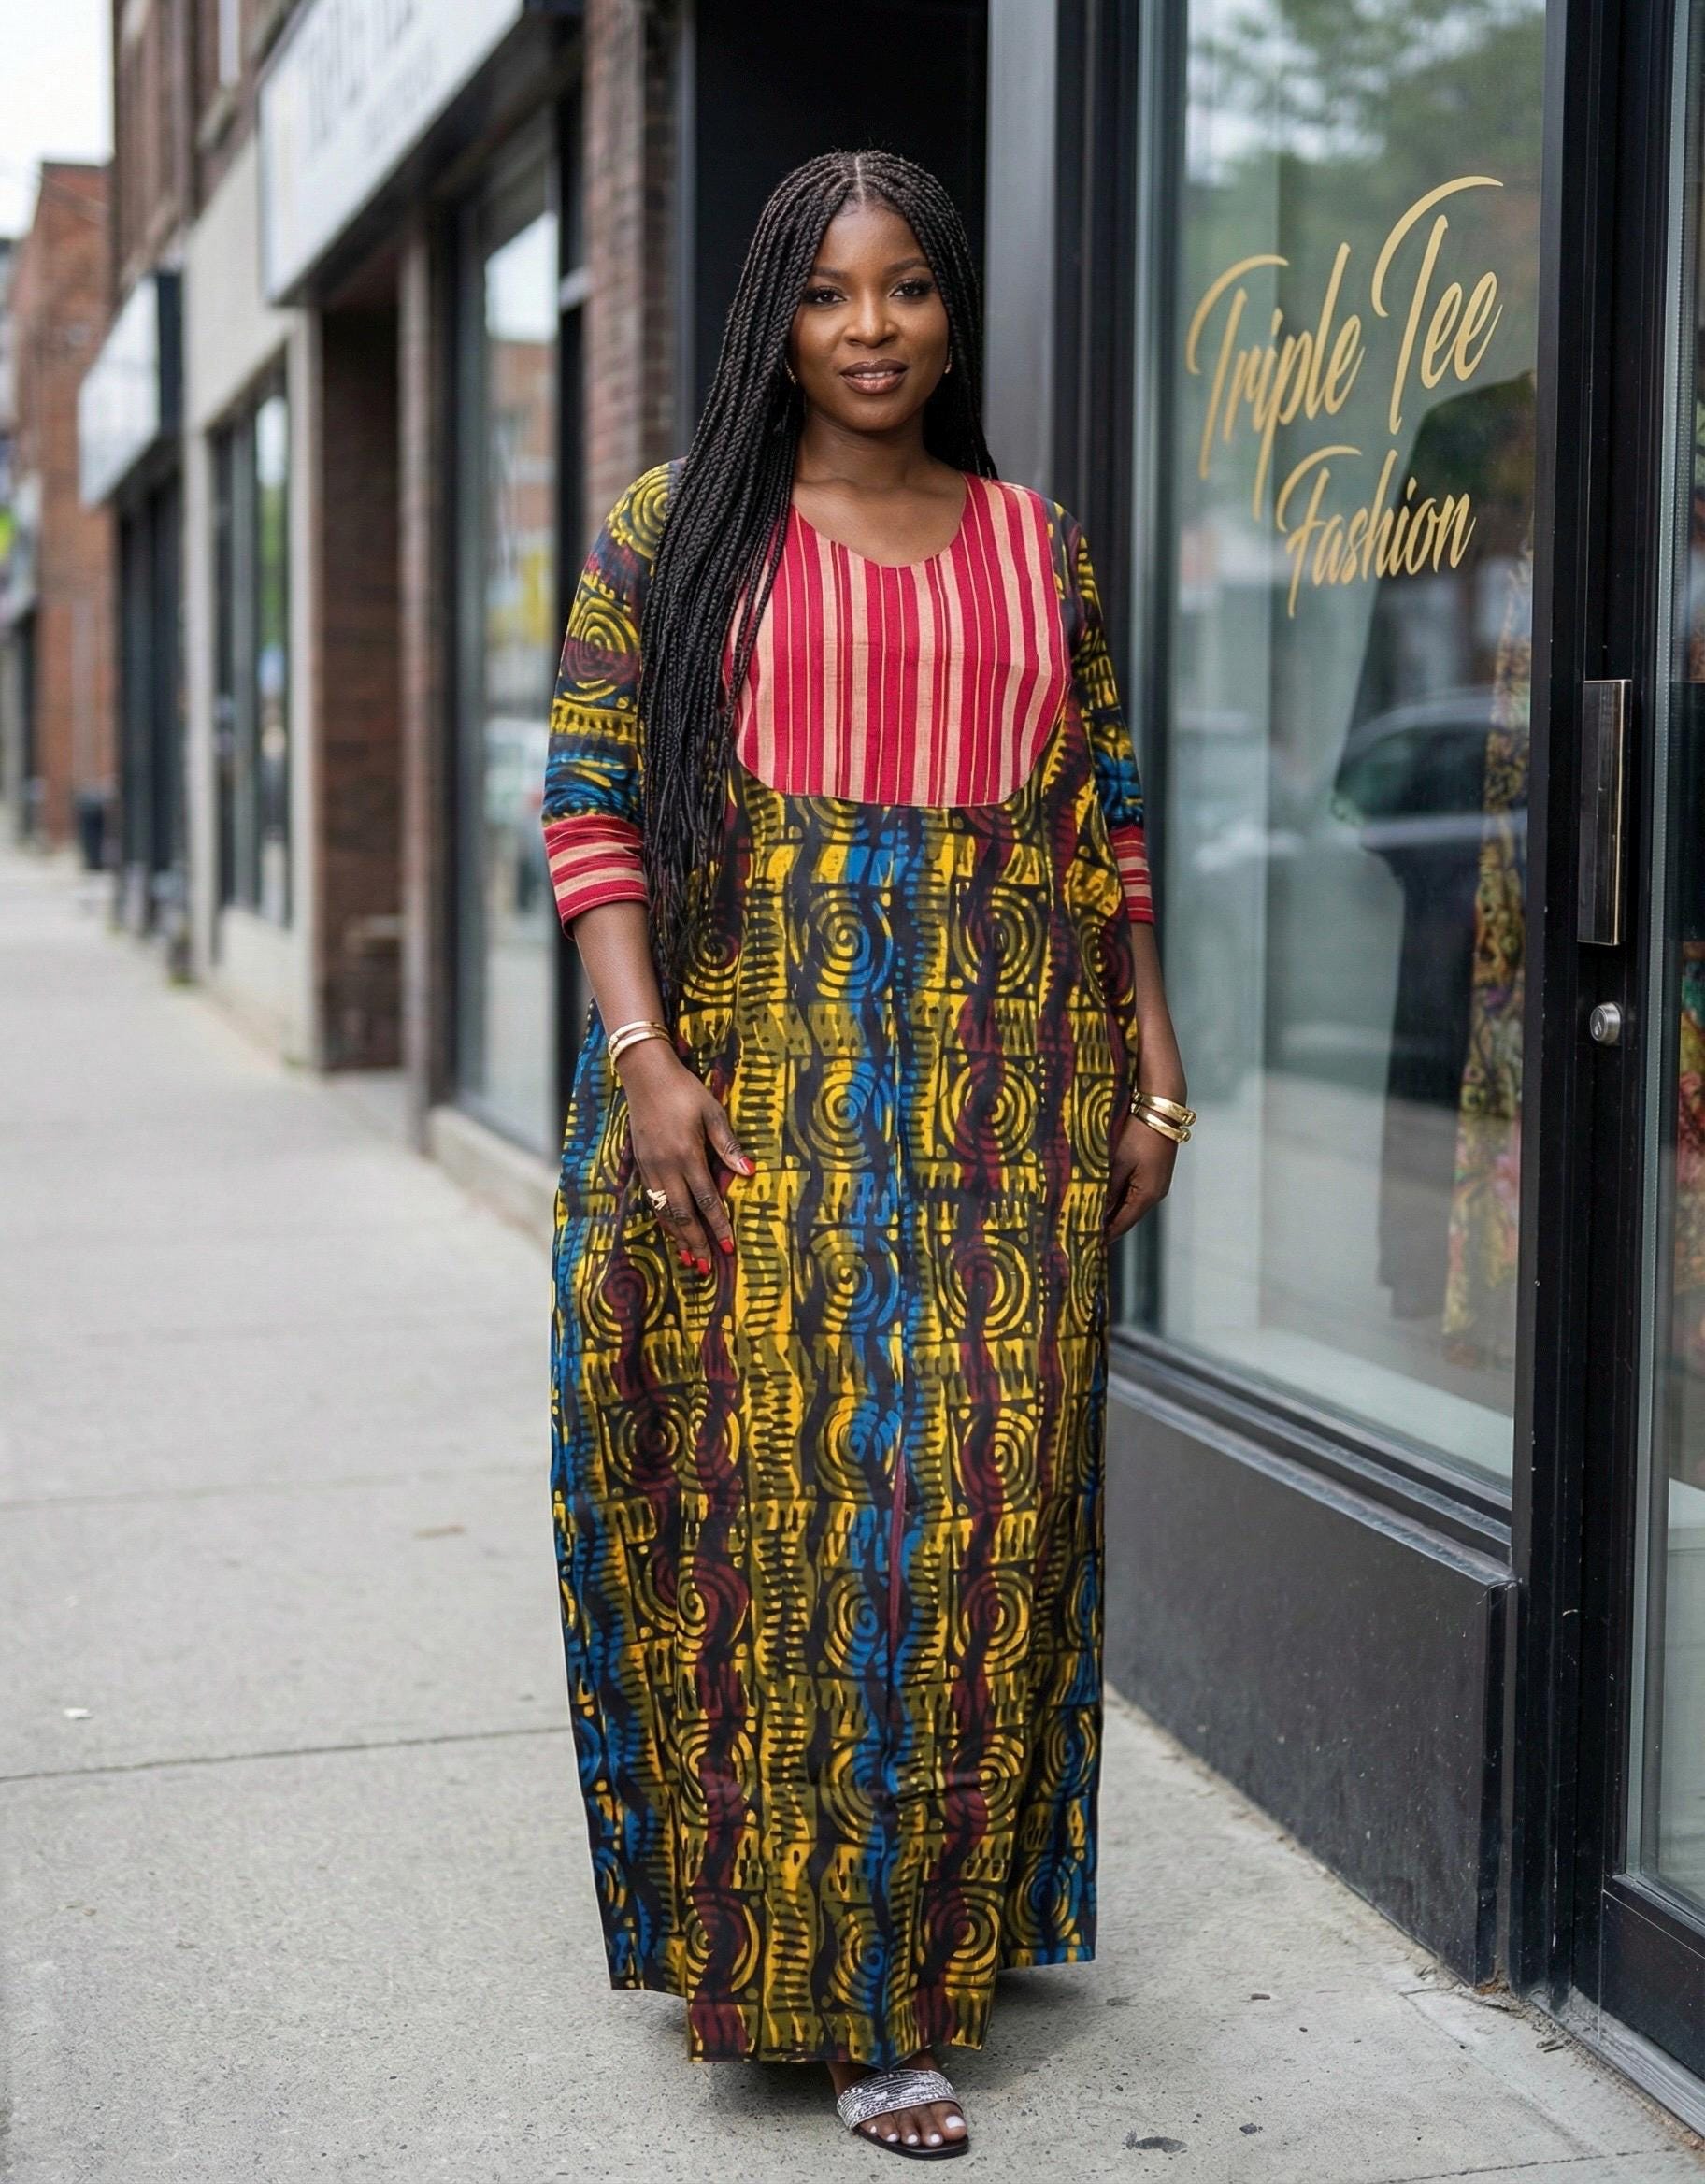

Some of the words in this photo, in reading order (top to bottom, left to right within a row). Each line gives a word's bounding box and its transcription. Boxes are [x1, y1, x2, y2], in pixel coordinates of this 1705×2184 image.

[1186, 242, 1365, 523] Triple
[1371, 176, 1504, 435] Tee
[1277, 445, 1477, 618] Fashion
